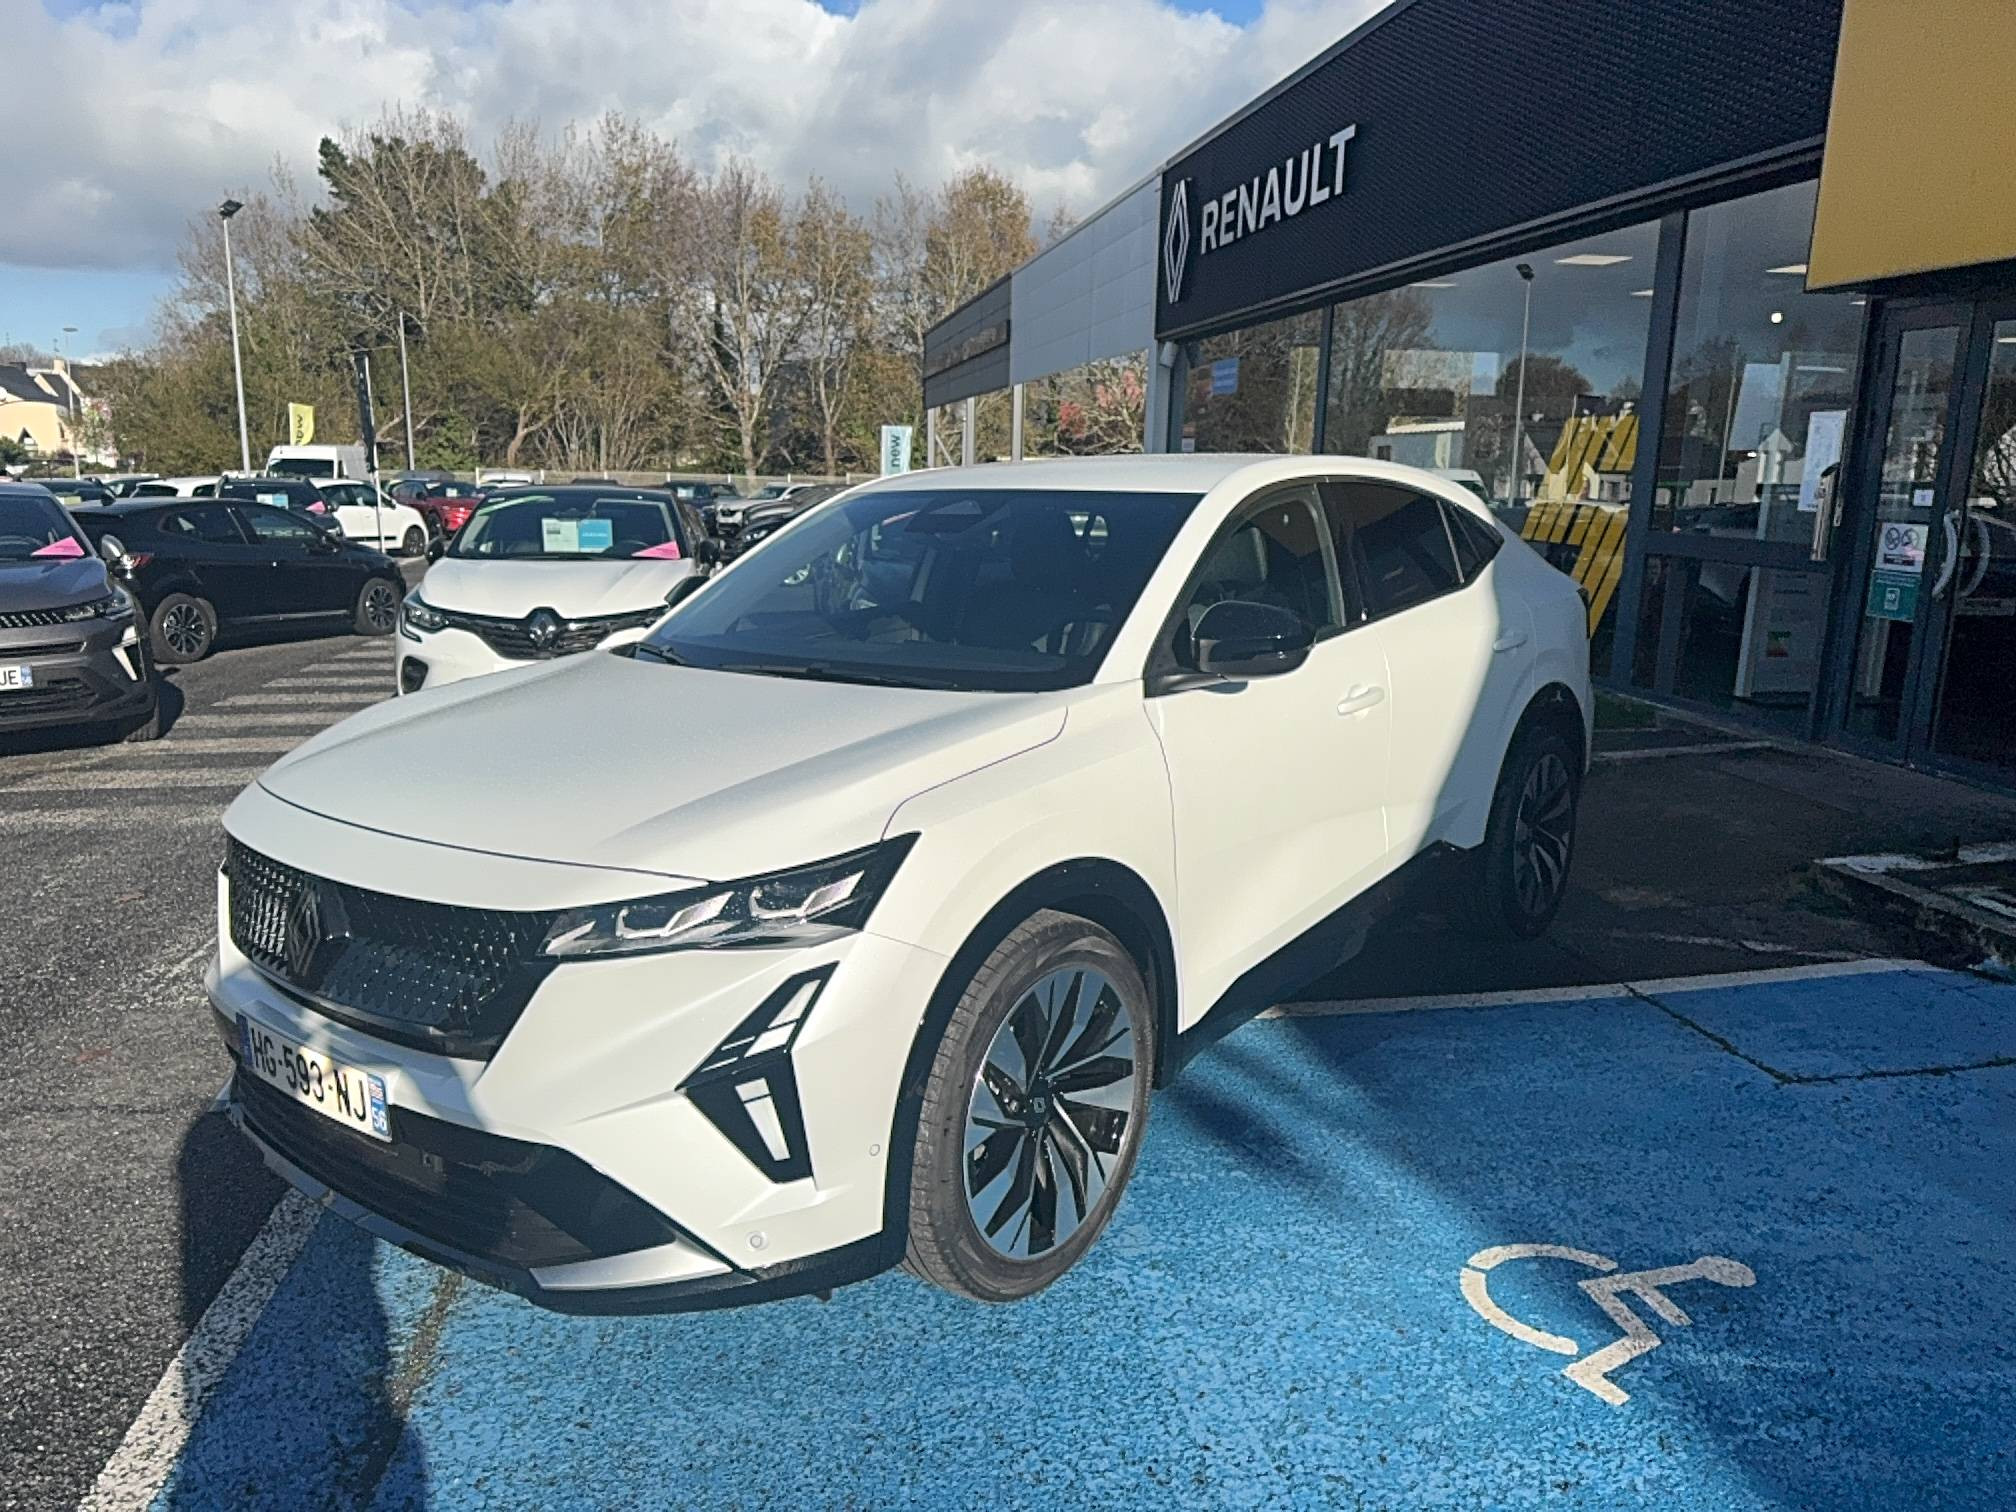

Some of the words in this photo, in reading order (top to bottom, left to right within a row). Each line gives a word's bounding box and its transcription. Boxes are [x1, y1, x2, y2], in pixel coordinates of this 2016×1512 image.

[1200, 123, 1357, 255] RENAULT
[890, 434, 901, 468] new
[251, 1027, 367, 1122] HG-593-NJ
